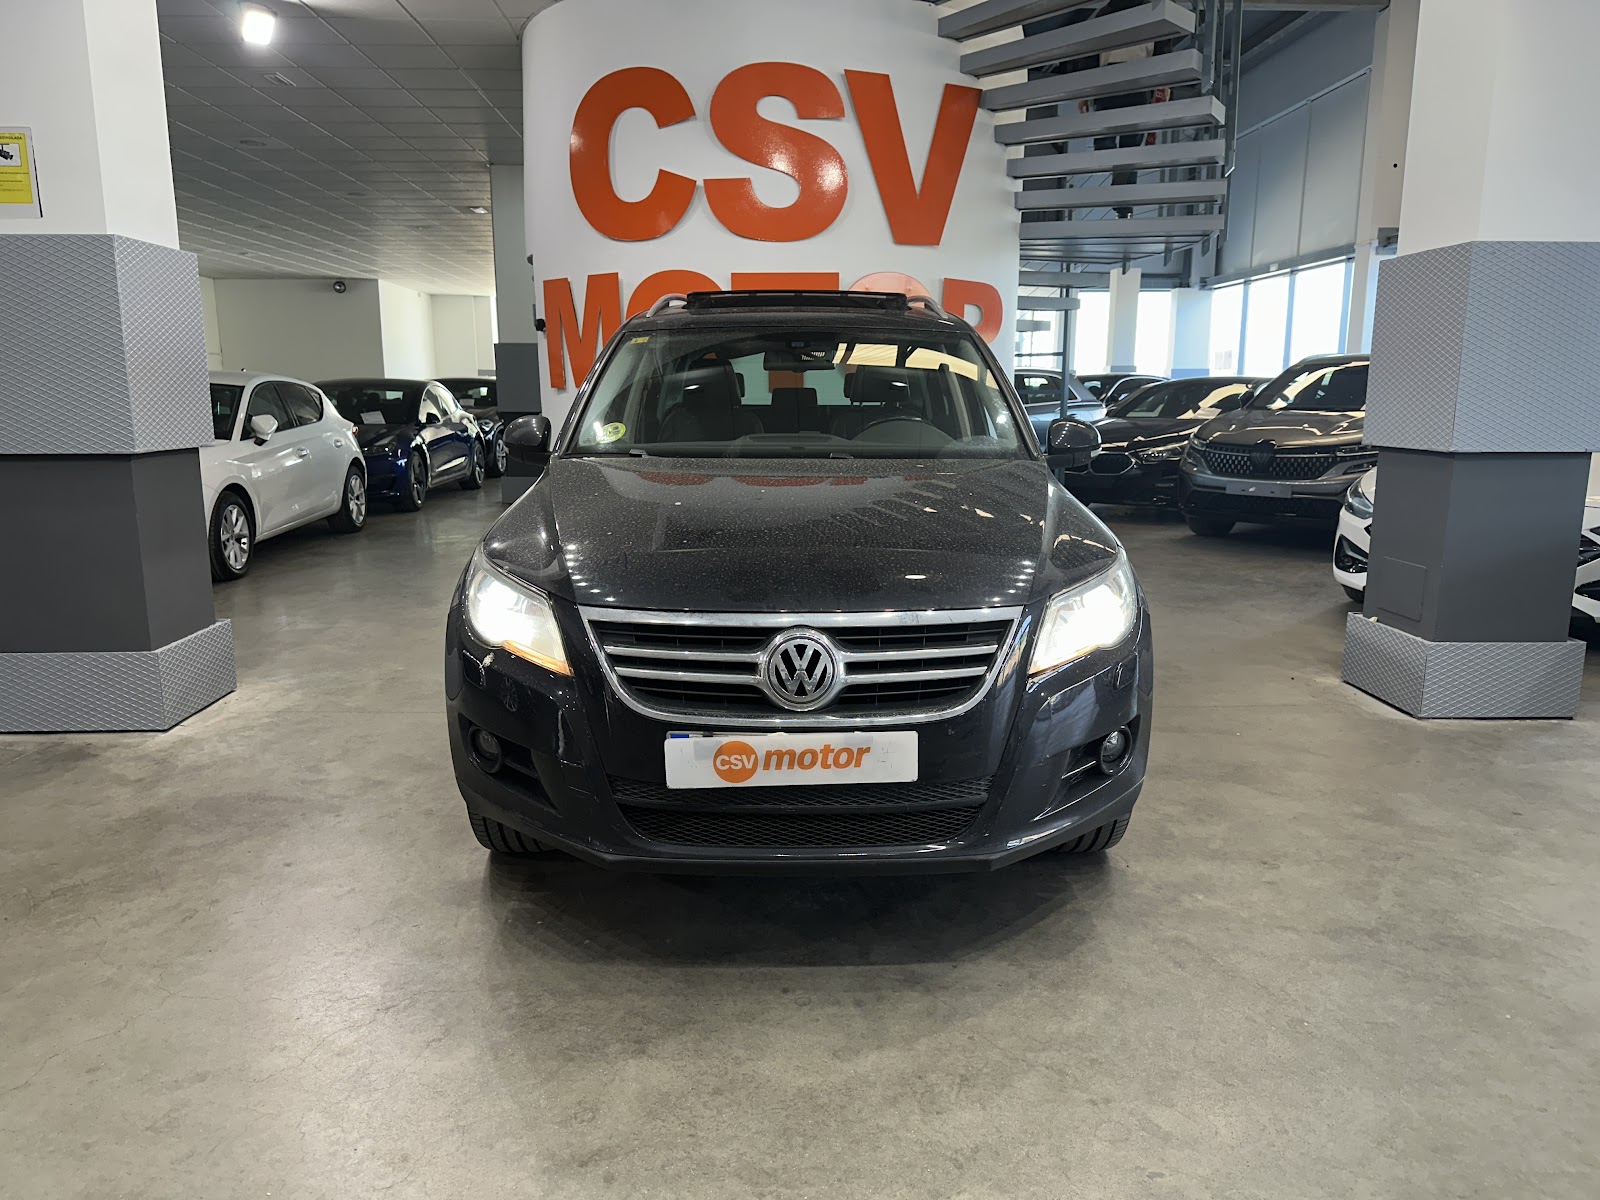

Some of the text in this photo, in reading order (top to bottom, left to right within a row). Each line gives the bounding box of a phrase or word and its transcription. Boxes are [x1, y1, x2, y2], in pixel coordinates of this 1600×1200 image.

[569, 61, 983, 246] CSV
[542, 269, 1004, 390] MTR
[715, 744, 871, 772] CSV motor
